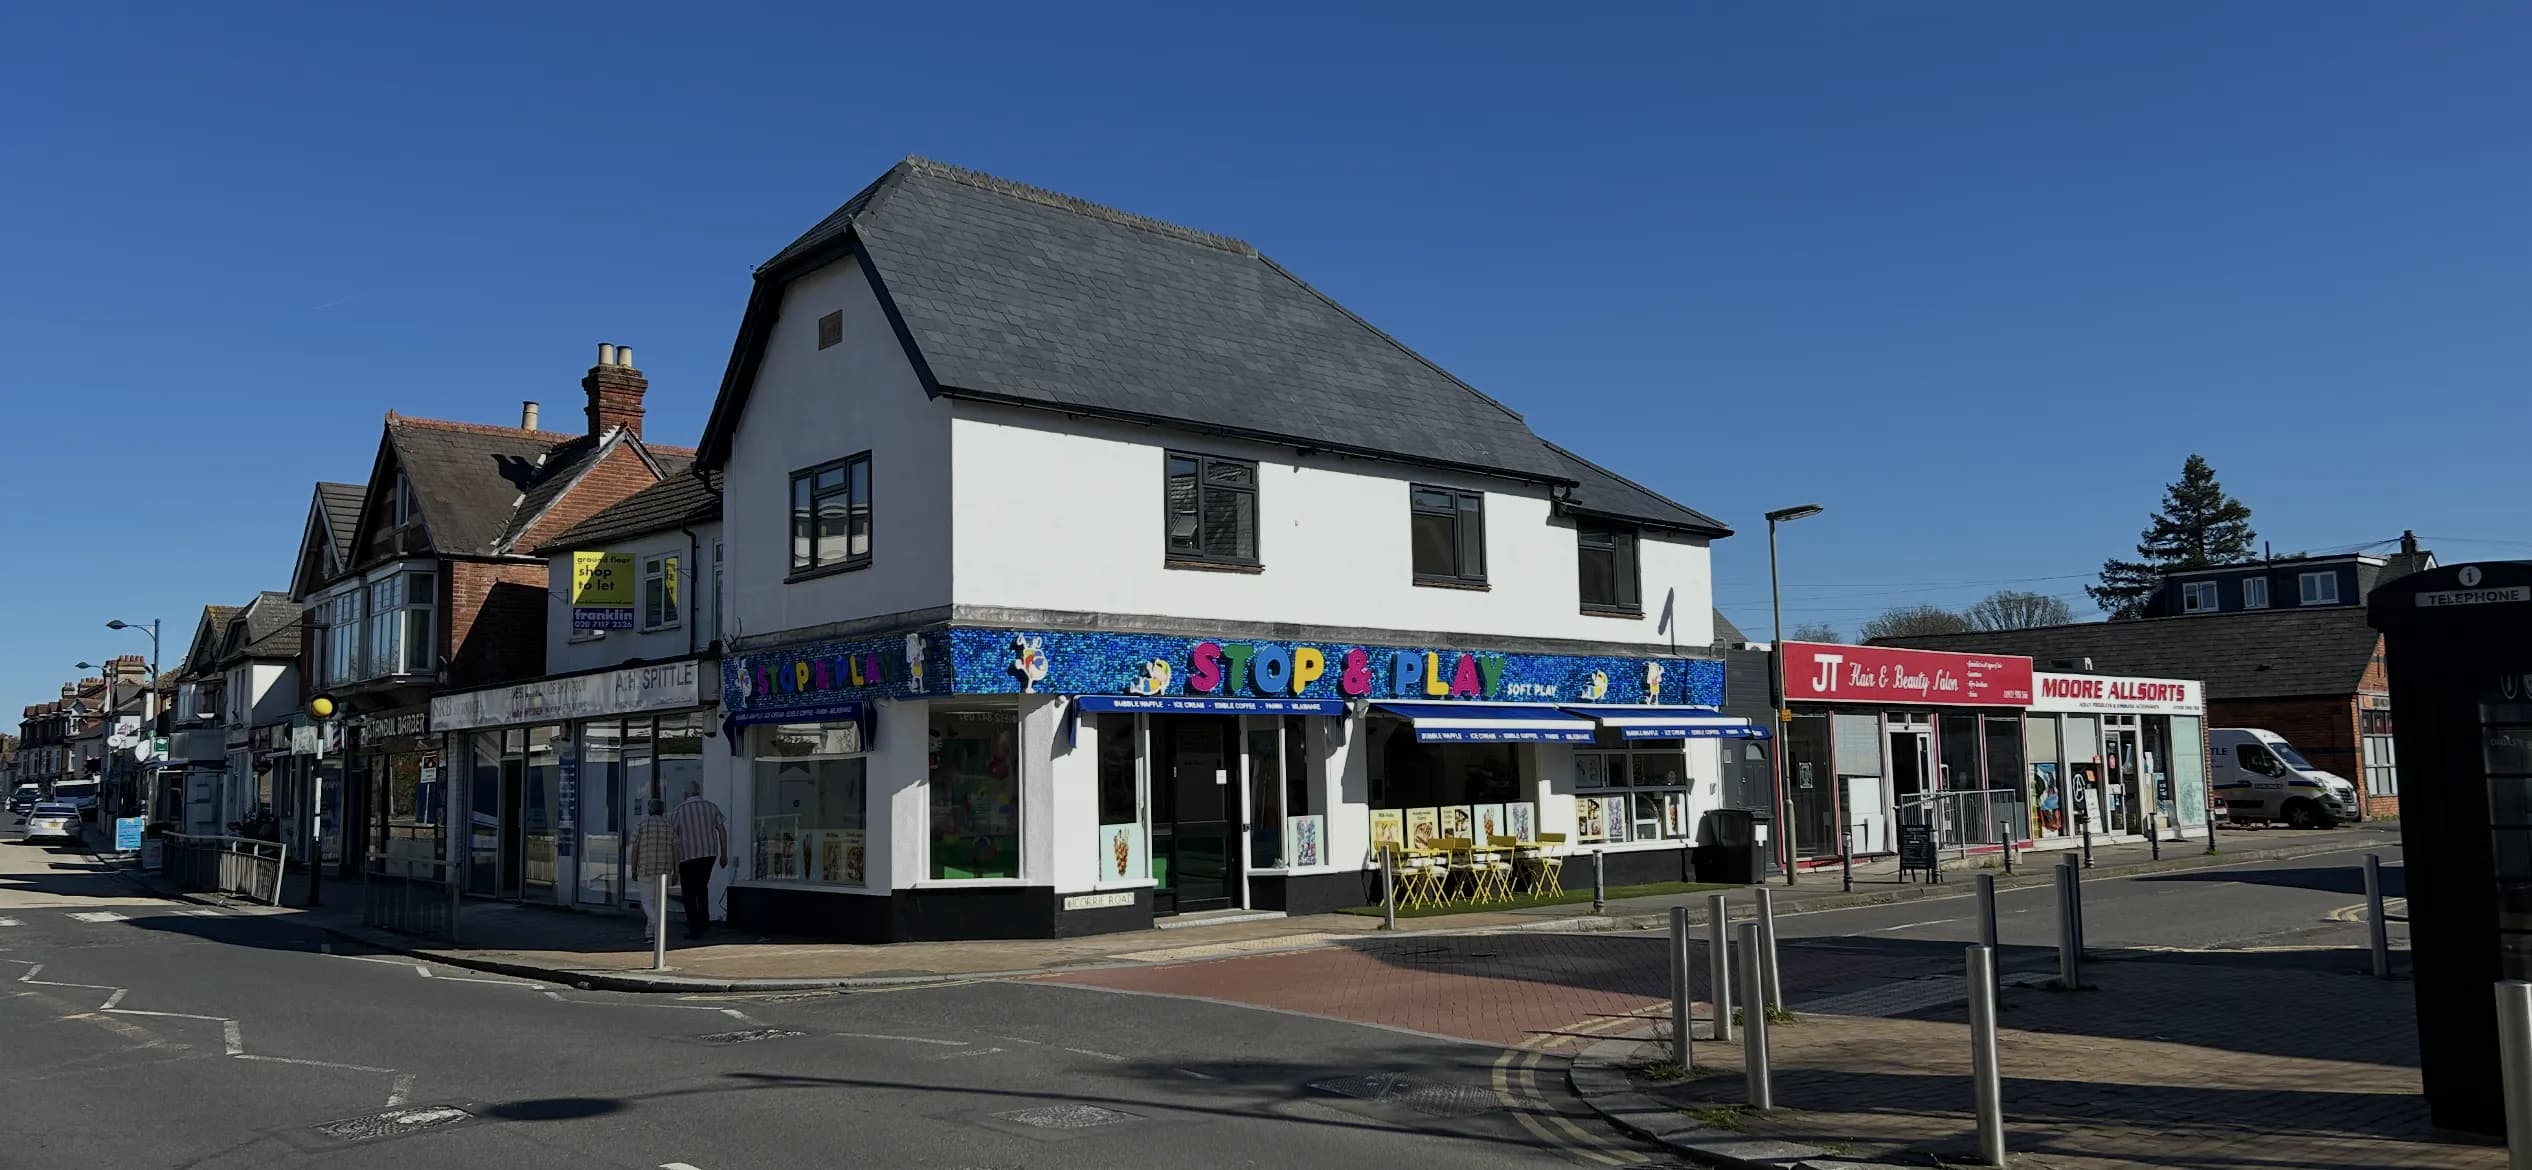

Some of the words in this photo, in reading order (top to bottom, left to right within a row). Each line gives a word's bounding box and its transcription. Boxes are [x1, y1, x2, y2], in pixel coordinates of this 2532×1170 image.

[577, 556, 608, 565] ground
[610, 556, 631, 564] floor
[578, 565, 612, 580] shop
[578, 581, 592, 590] to
[598, 579, 615, 591] let
[2429, 590, 2520, 605] TELEPHONE
[574, 608, 633, 621] franklin
[643, 665, 692, 689] SPITTLE
[757, 660, 809, 696] STOP
[1191, 642, 1325, 695] STOP
[1342, 648, 1371, 695] &
[1395, 651, 1504, 697] PLAY
[1812, 653, 1843, 692] JT
[1507, 682, 1531, 696] SOFT
[1534, 683, 1557, 697] PLAY
[1849, 662, 1875, 687] Hair
[1878, 665, 1889, 688] &
[1892, 664, 1930, 698] Beauty
[1932, 668, 1959, 692] Salon
[2041, 678, 2104, 699] MOORE
[2108, 681, 2185, 702] ALLSORTS
[397, 713, 425, 736] BARBER
[1108, 894, 1133, 905] ROAD
